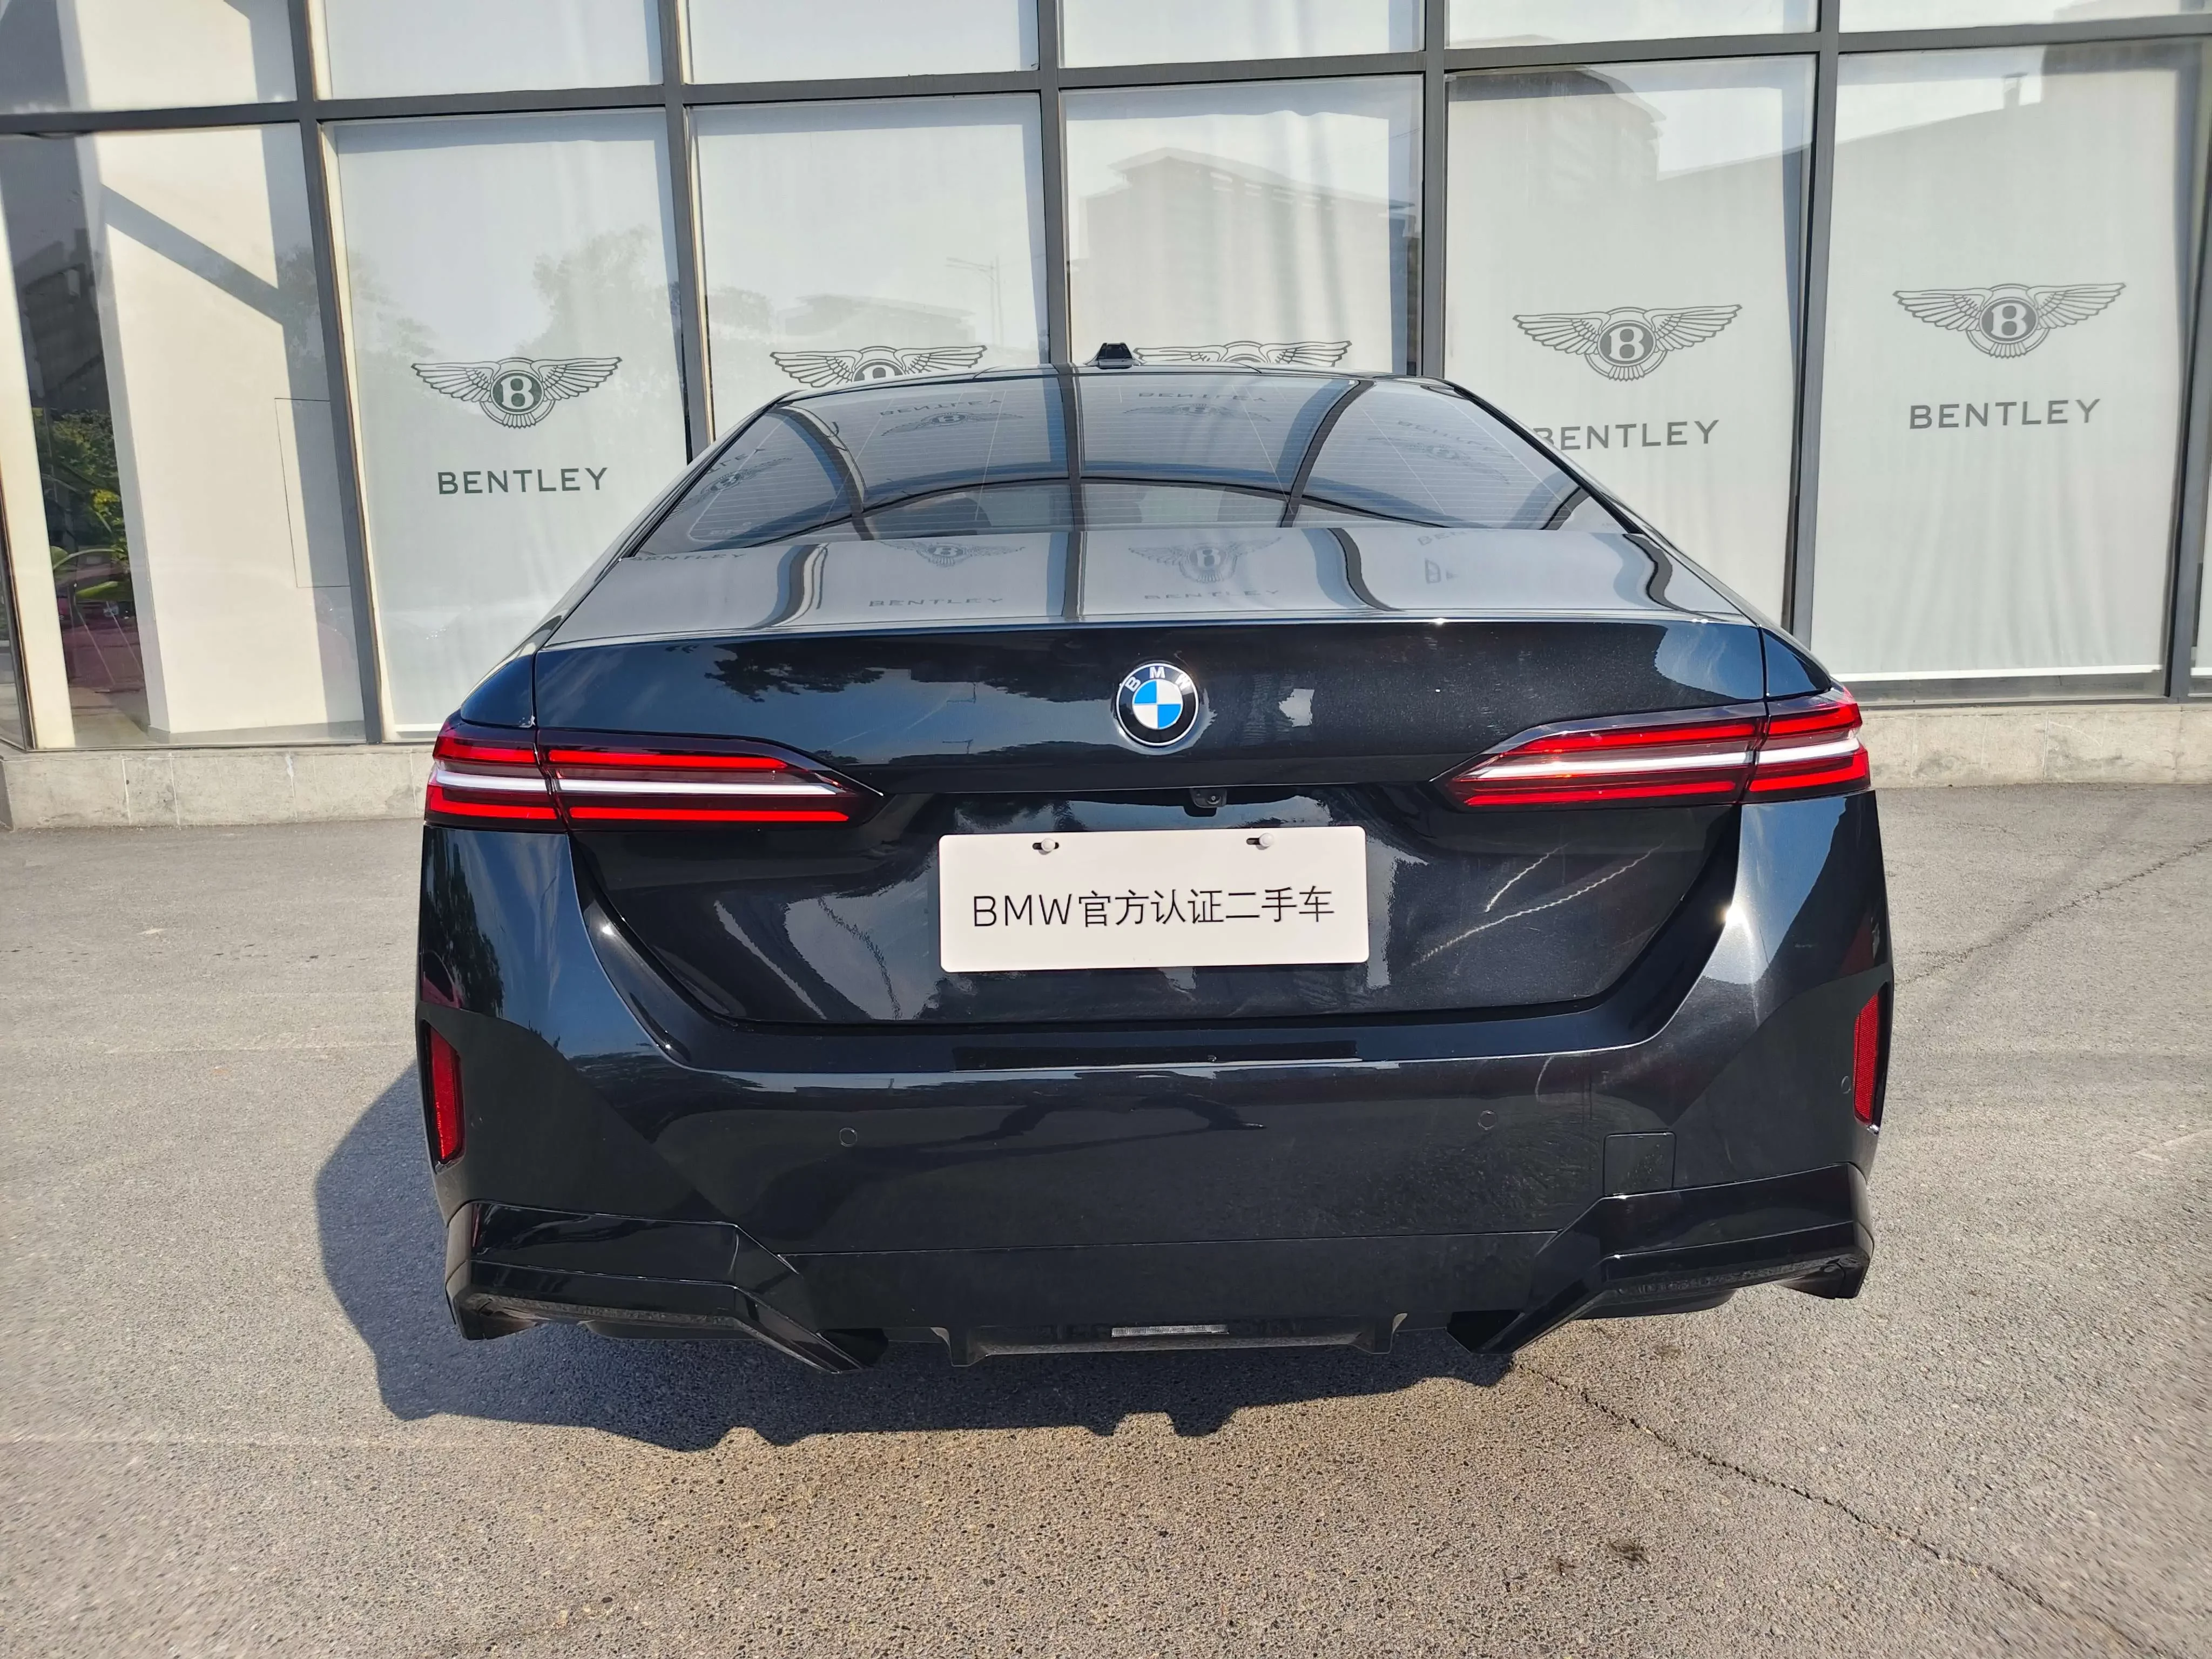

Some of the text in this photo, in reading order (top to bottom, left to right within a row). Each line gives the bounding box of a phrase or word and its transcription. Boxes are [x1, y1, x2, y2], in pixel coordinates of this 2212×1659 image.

[1910, 399, 2100, 429] BENTLEY
[438, 468, 607, 495] BENTLEY
[1124, 666, 1194, 692] BMW
[973, 885, 1335, 928] BMW官方认证二手车
